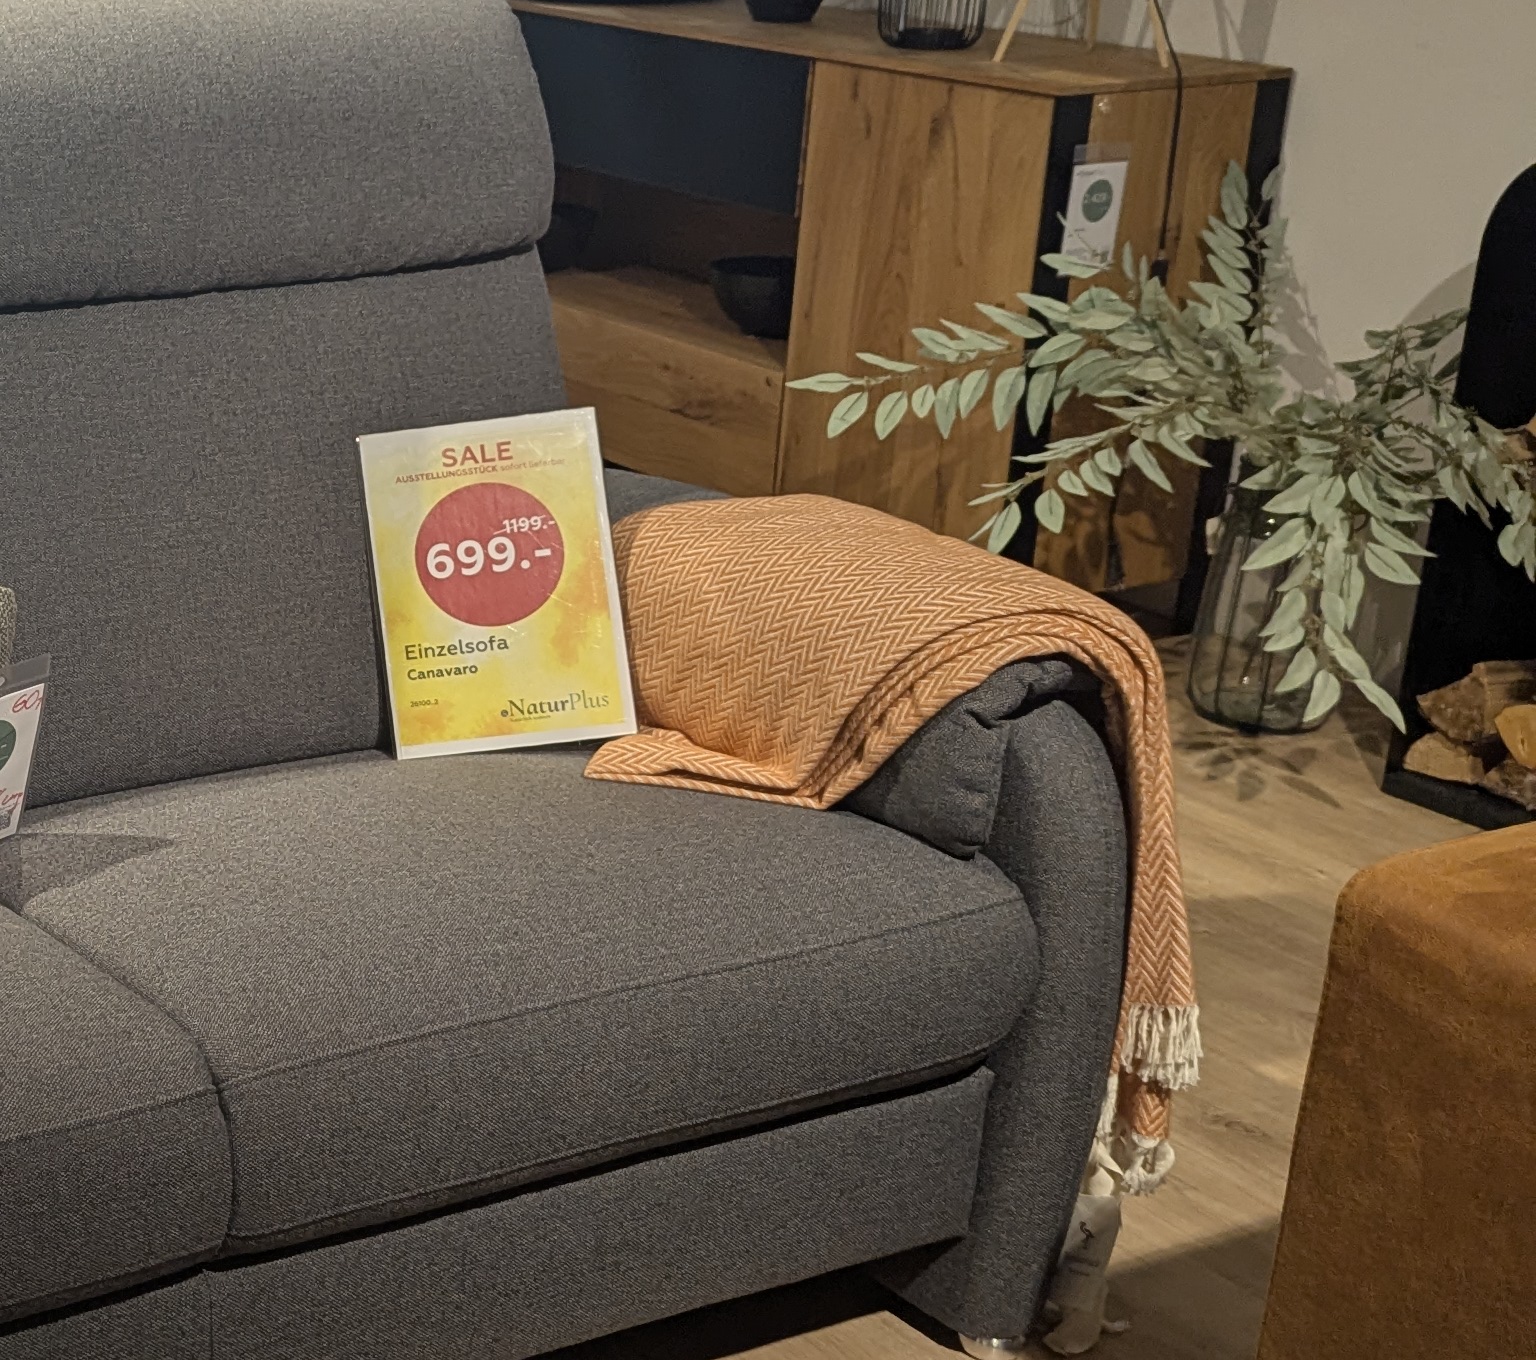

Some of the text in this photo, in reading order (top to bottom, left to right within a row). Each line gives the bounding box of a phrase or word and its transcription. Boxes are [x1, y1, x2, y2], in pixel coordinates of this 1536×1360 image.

[441, 441, 514, 468] SALE
[395, 465, 498, 484] AUSSTELLUNGSSTÜCK
[499, 461, 527, 472] sofort
[502, 515, 556, 534] 1199.-
[426, 536, 552, 579] 699.-
[404, 635, 509, 660] Einzelsofa
[407, 664, 479, 681] Canavaro
[507, 690, 610, 717] NaturPlus
